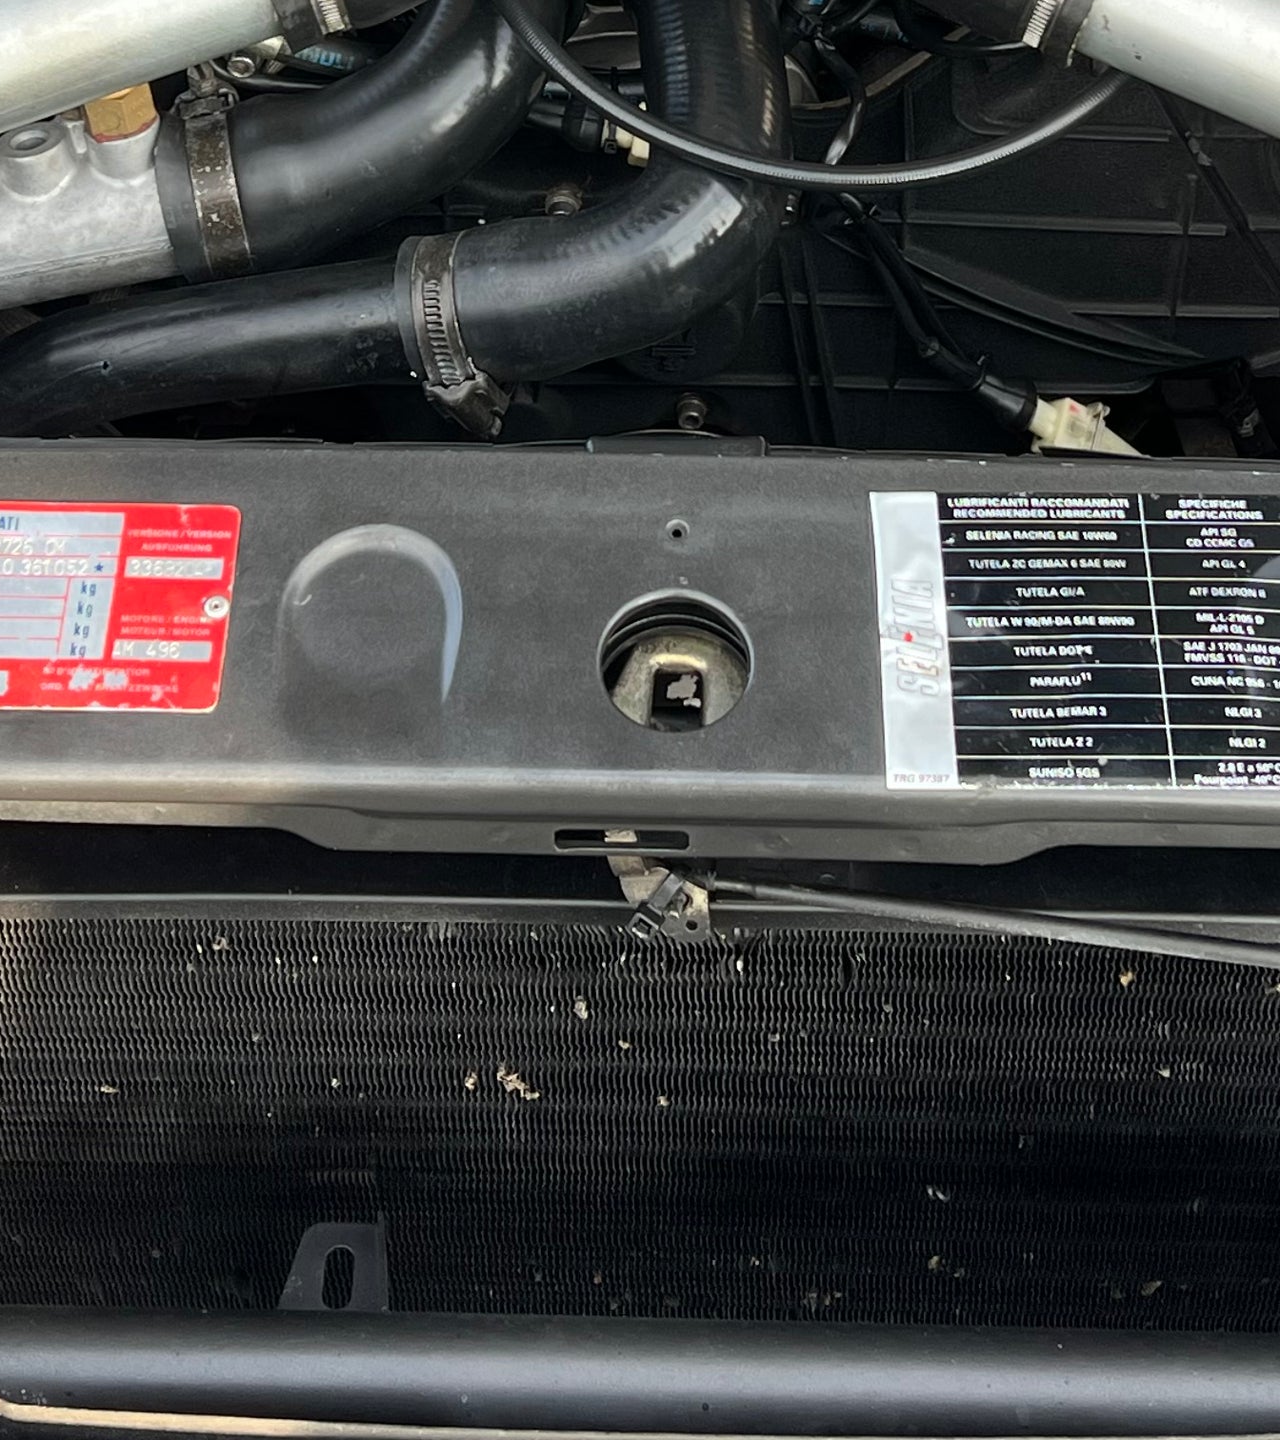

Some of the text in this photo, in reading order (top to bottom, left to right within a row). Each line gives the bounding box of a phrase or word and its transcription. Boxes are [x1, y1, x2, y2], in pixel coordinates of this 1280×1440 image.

[947, 497, 1130, 509] LUBRIFICANTI RACCOMANDATI
[1178, 499, 1248, 510] SPECIFICHE
[952, 509, 1126, 519] RECOMMENDED LUBRICANTS
[1165, 509, 1264, 521] SPECIFICATIONS
[965, 530, 1012, 541] SELENIA
[1013, 530, 1057, 541] RACING
[1058, 531, 1080, 541] SAE
[1200, 527, 1220, 537] API
[968, 558, 1011, 569] TUTELA
[1080, 558, 1102, 569] SAE
[1202, 559, 1247, 569] API GL 4
[81, 581, 97, 596] kg
[1015, 586, 1059, 598] TUTELA
[1188, 587, 1257, 599] ATF DEXRON
[77, 601, 93, 617] kg
[965, 616, 1008, 627] TUTELA
[1010, 617, 1022, 627] W
[1073, 616, 1096, 627] SAE
[1254, 615, 1265, 625] D
[73, 622, 90, 638] kg
[1209, 624, 1229, 634] API
[884, 578, 947, 699] SELENIA
[70, 642, 86, 658] kg
[1012, 645, 1058, 657] TUTELA
[1183, 641, 1207, 651] SAE
[1207, 642, 1216, 652] J
[1243, 643, 1267, 654] JAN
[1184, 652, 1226, 664] FMVSS
[1253, 654, 1278, 666] DOT
[1191, 675, 1226, 687] CUNA
[1009, 707, 1055, 719] TUTELA
[1098, 706, 1108, 717] 3
[1224, 707, 1263, 719] NLGI 3
[1029, 736, 1075, 748] TUTELA
[1085, 737, 1094, 748] 2
[1228, 737, 1267, 749] NLGI 2
[1028, 767, 1075, 779] SUNISO
